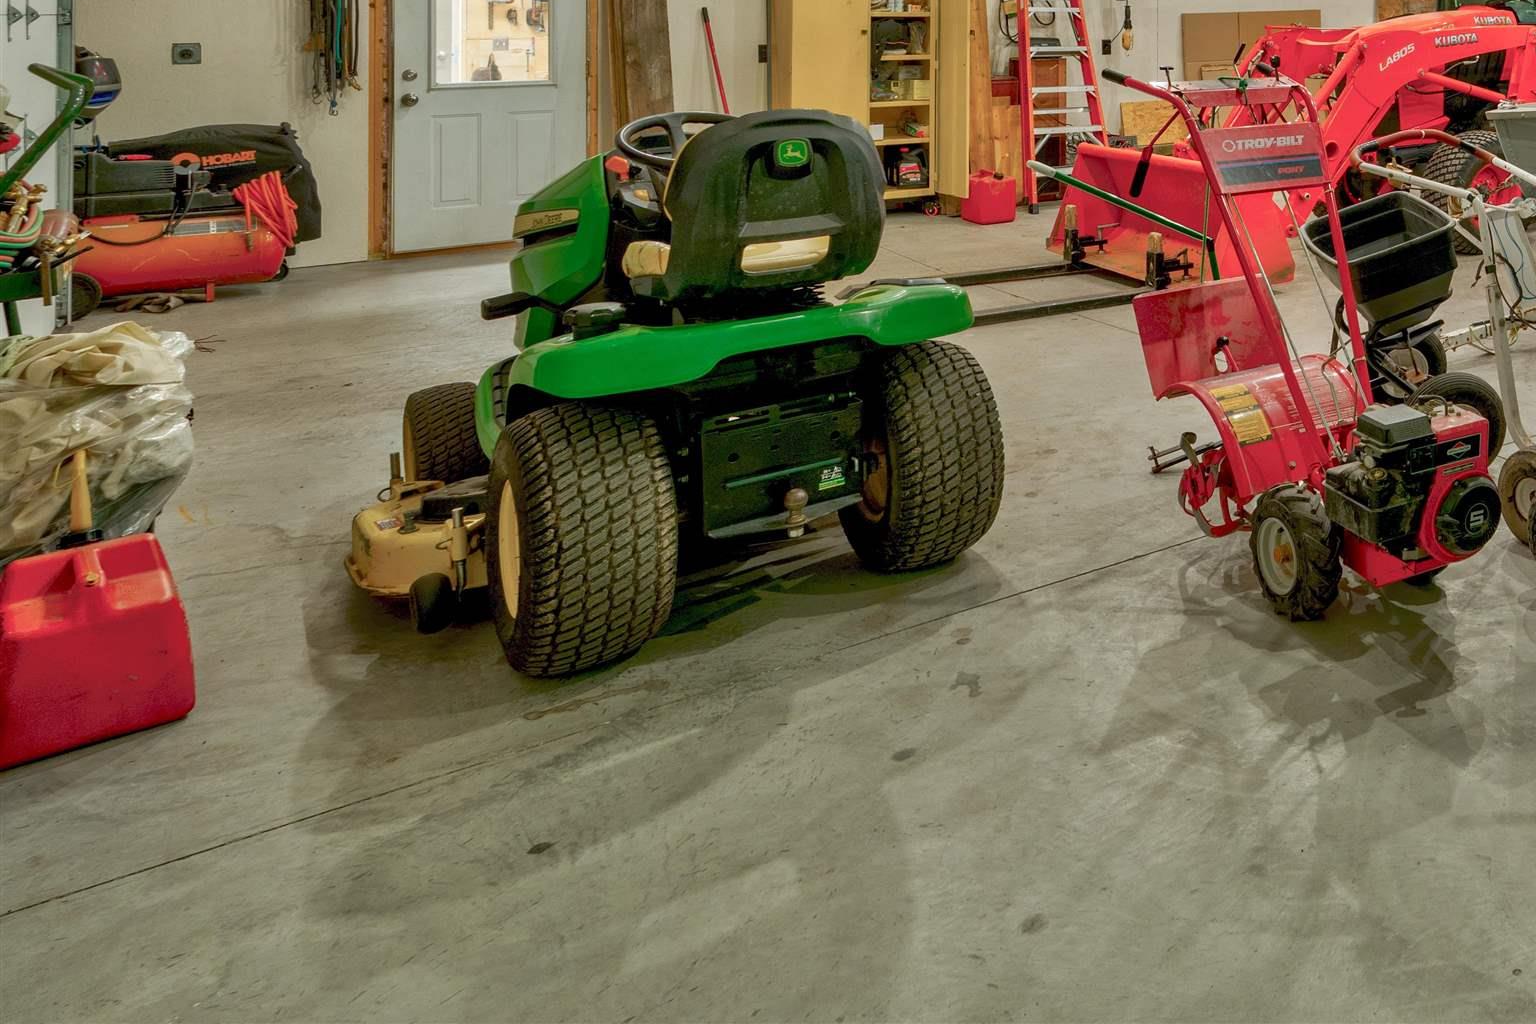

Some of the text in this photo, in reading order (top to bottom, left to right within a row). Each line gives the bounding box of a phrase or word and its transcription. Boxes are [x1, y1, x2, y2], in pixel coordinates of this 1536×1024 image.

[1473, 15, 1513, 25] KUBOTA
[1434, 32, 1478, 48] KUBOTA
[1379, 42, 1416, 72] LA805
[1235, 135, 1305, 151] TROY-BILT
[201, 150, 257, 167] HOBART
